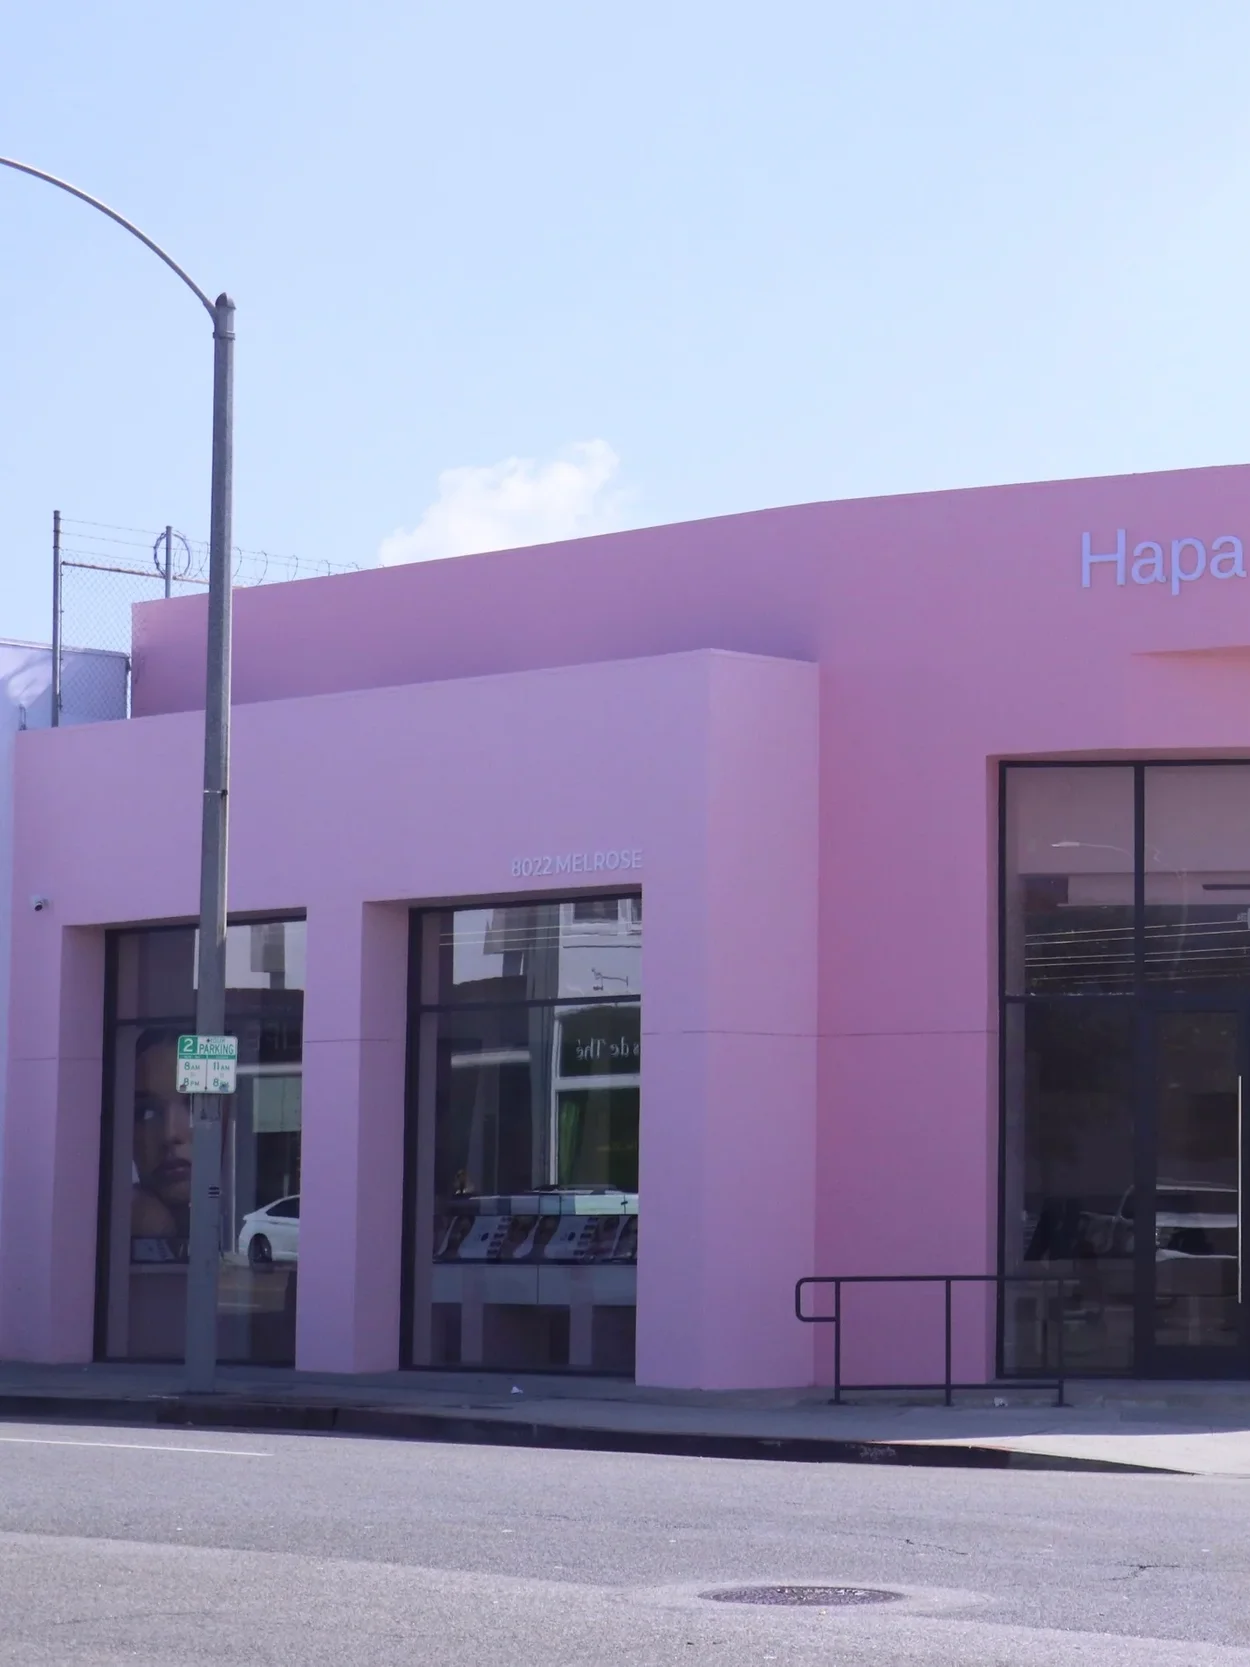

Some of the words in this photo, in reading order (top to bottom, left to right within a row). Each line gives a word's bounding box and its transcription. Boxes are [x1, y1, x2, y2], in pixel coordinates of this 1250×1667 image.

[1082, 529, 1247, 595] Hapa
[511, 858, 552, 876] 8022
[555, 850, 643, 873] MELROSE
[183, 1038, 194, 1052] 2
[199, 1044, 234, 1055] PARKING
